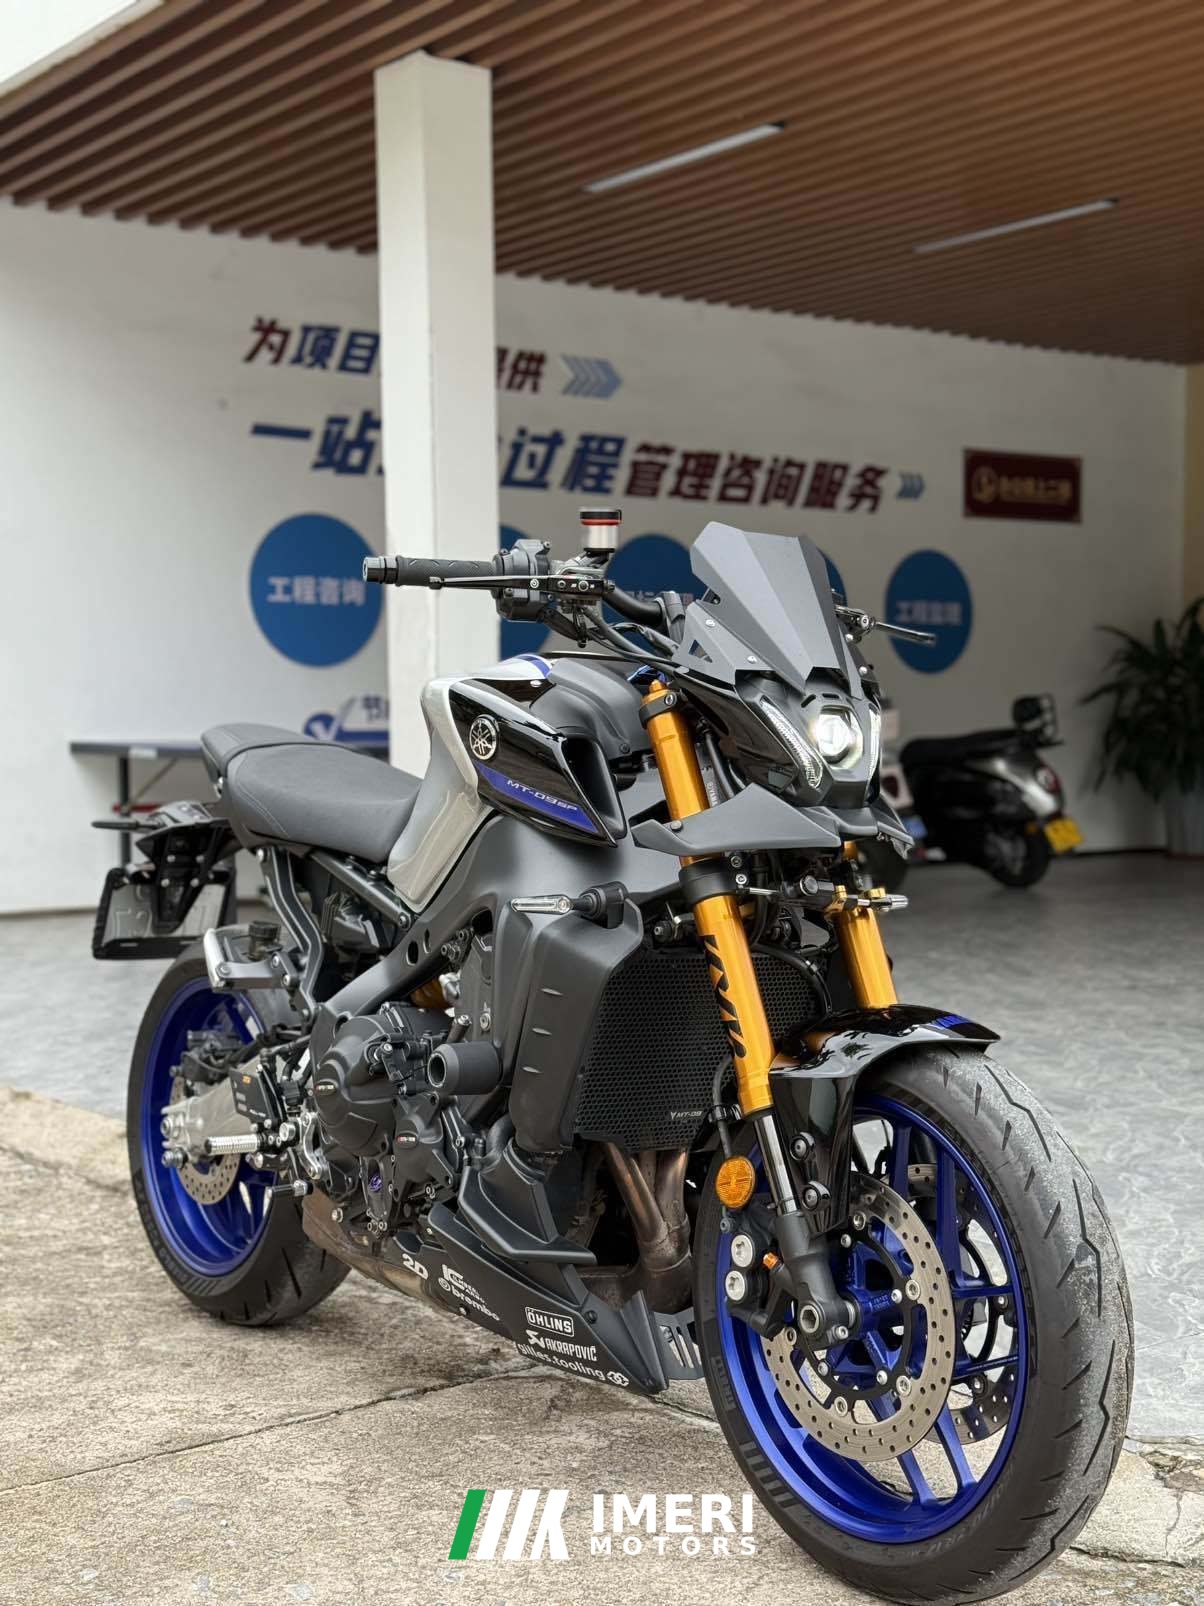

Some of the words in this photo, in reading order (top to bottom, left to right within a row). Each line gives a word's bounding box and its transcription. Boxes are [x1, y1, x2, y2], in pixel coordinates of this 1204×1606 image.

[243, 317, 380, 374] 为项目
[251, 410, 384, 475] 一站
[451, 1285, 500, 1321] brembo
[527, 1308, 572, 1334] ÖHLINS
